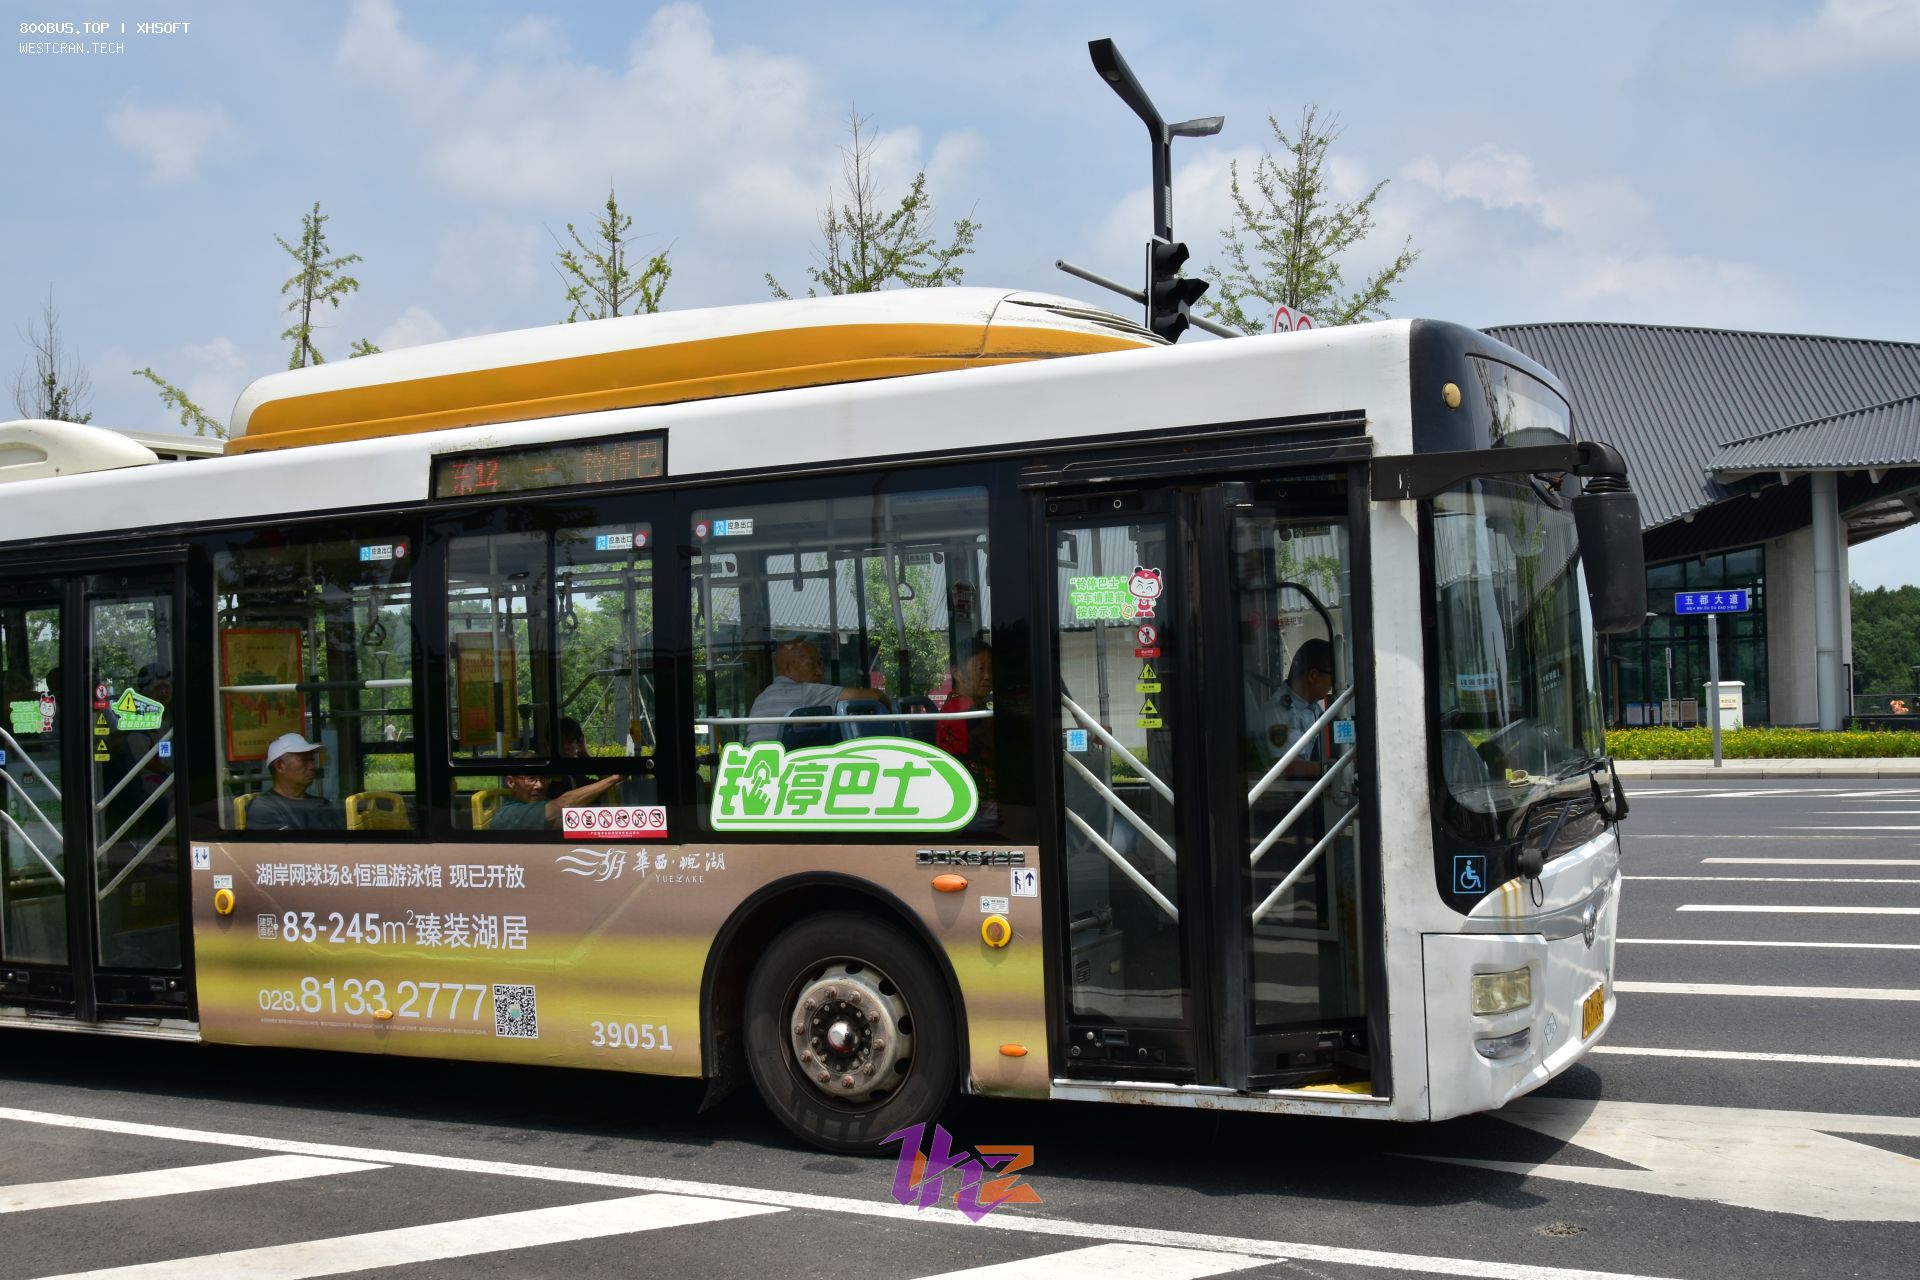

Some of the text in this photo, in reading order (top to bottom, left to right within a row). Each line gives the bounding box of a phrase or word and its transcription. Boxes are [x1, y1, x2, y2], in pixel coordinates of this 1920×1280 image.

[1684, 593, 1739, 605] 五都大道
[1070, 731, 1084, 746] 推
[719, 748, 932, 816] 铃停巴士
[256, 863, 526, 889] 湖岸网球场&恒温游泳馆 现已开放
[591, 1021, 673, 1051] 39051
